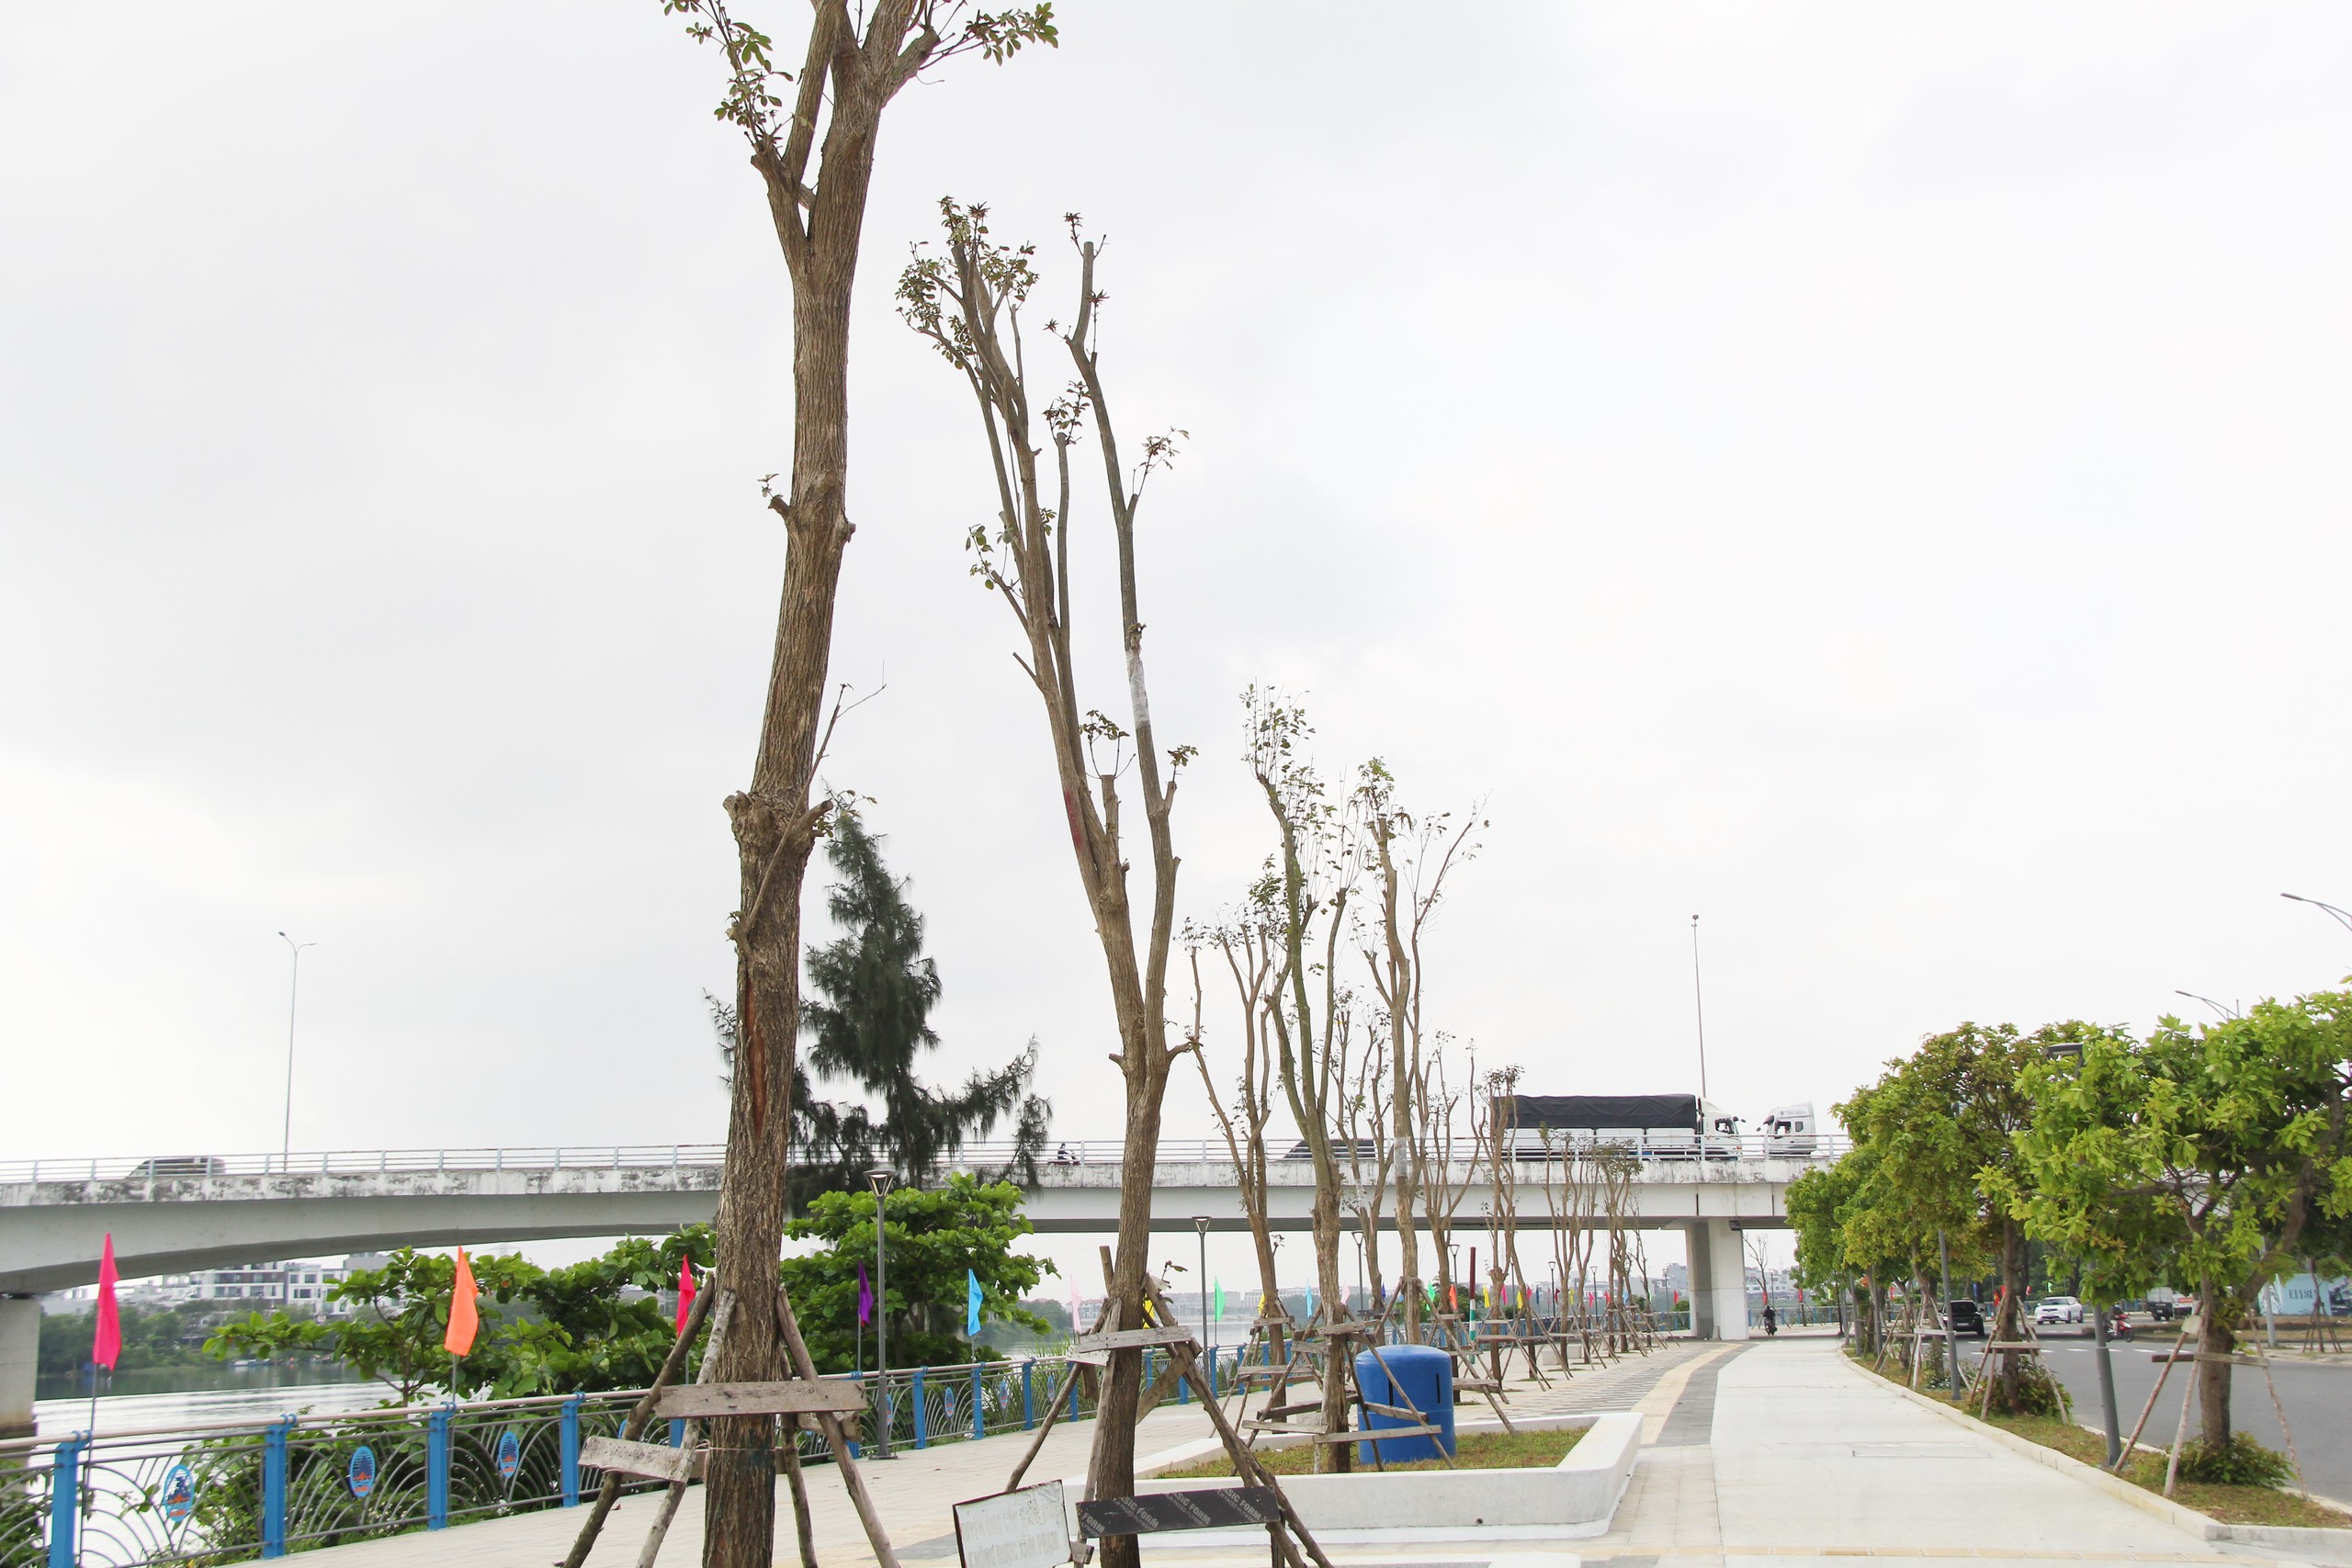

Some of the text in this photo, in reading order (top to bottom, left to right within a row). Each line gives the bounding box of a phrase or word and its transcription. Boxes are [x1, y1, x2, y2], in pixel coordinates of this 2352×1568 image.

[1136, 1507, 1159, 1529] FORM
[1189, 1503, 1211, 1525] FORM
[1239, 1499, 1262, 1520] FORM
[1081, 1512, 1105, 1534] FORM
